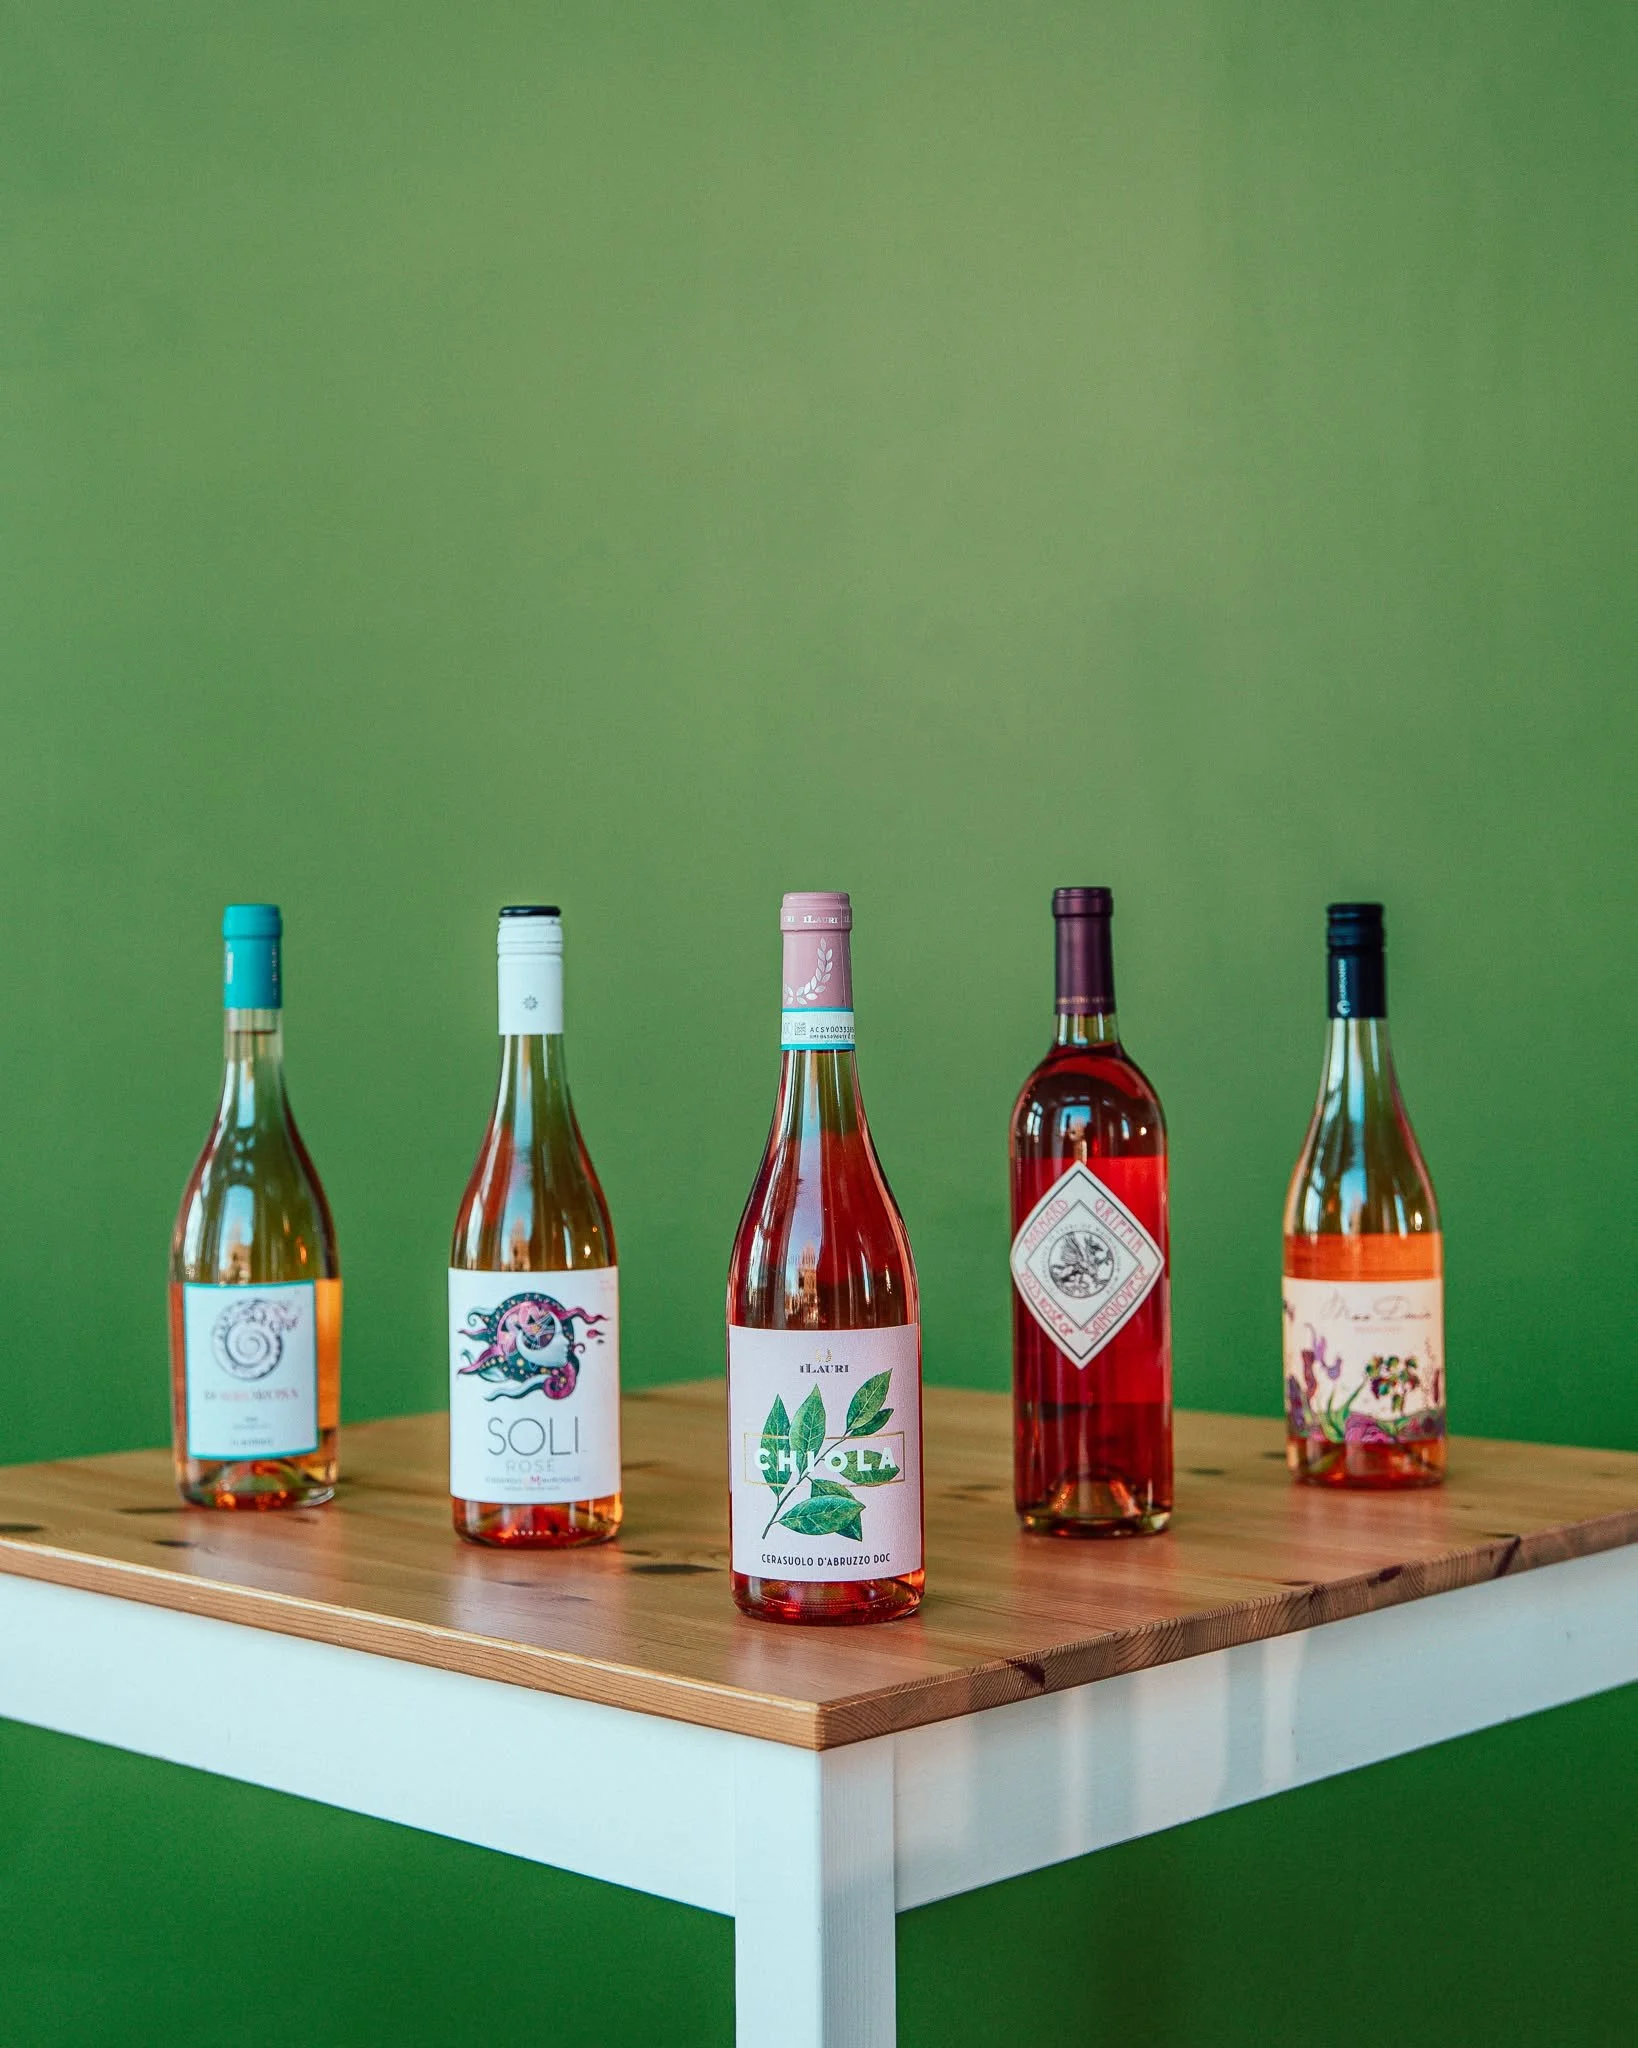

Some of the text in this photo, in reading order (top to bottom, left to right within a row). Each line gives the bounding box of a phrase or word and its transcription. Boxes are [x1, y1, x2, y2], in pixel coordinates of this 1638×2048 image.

[487, 1416, 579, 1456] SOLI
[754, 1447, 897, 1473] CHIOLA
[761, 1553, 891, 1567] CERASUOLO D'ABRUZZO DOC
